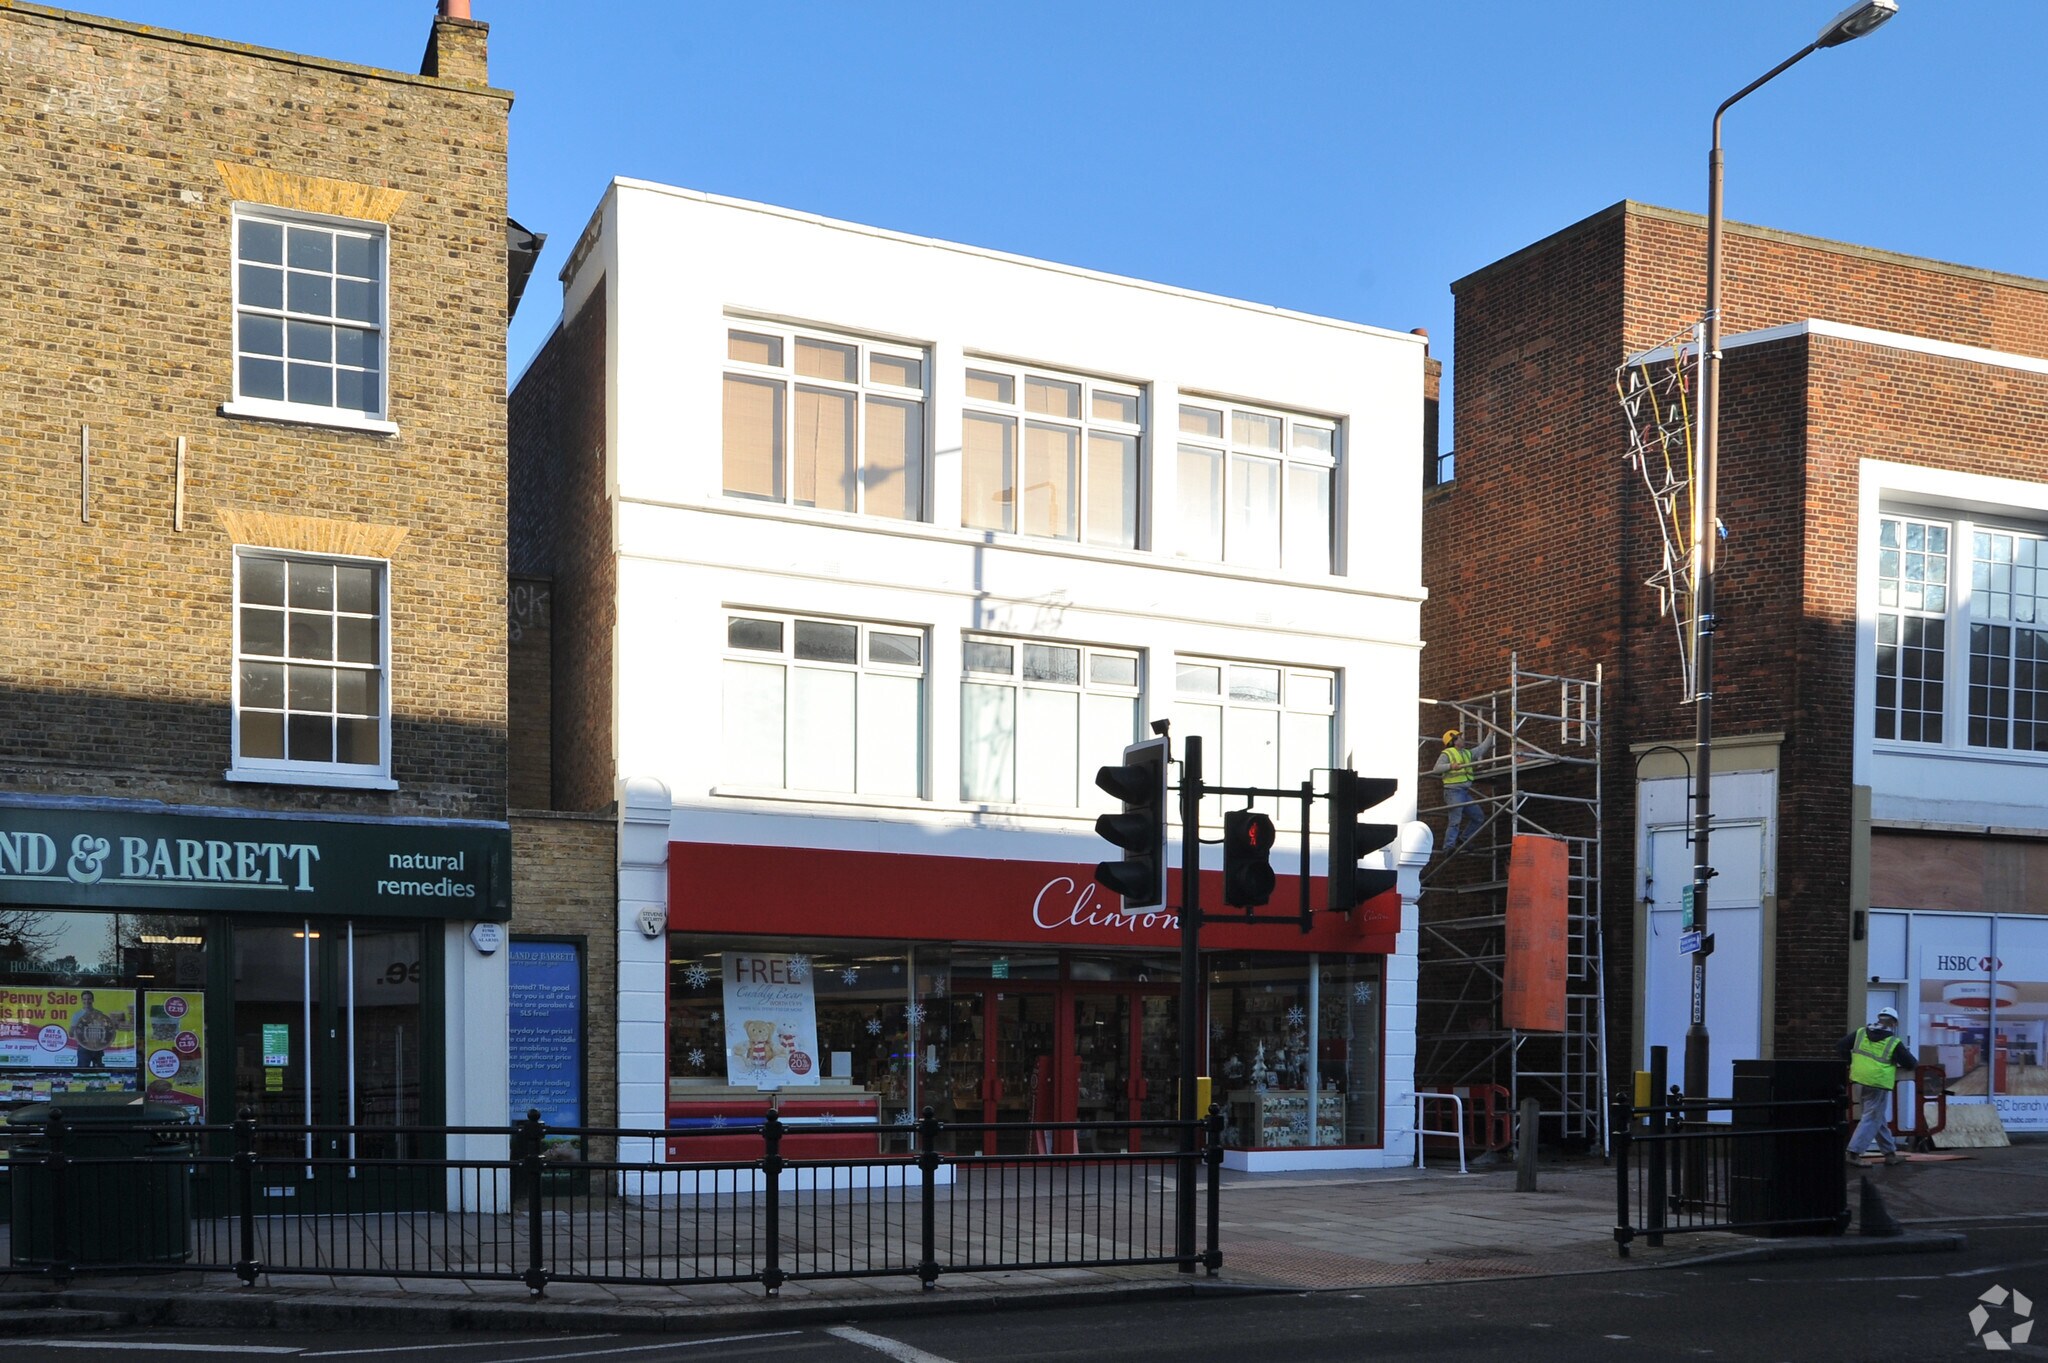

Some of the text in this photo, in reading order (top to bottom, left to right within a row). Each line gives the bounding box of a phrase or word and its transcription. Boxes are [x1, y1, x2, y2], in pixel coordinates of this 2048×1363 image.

[67, 833, 111, 885] &
[119, 836, 321, 892] BARRETT
[389, 851, 464, 871] natural
[377, 877, 476, 897] remedies
[540, 952, 575, 961] BARRETT
[1937, 956, 1977, 972] HSBC
[736, 957, 801, 985] FREE
[0, 990, 78, 1007] Penny Sale
[736, 984, 803, 1005] Cuddly Bear
[0, 1006, 67, 1020] is now on
[2012, 1099, 2041, 1111] branch
